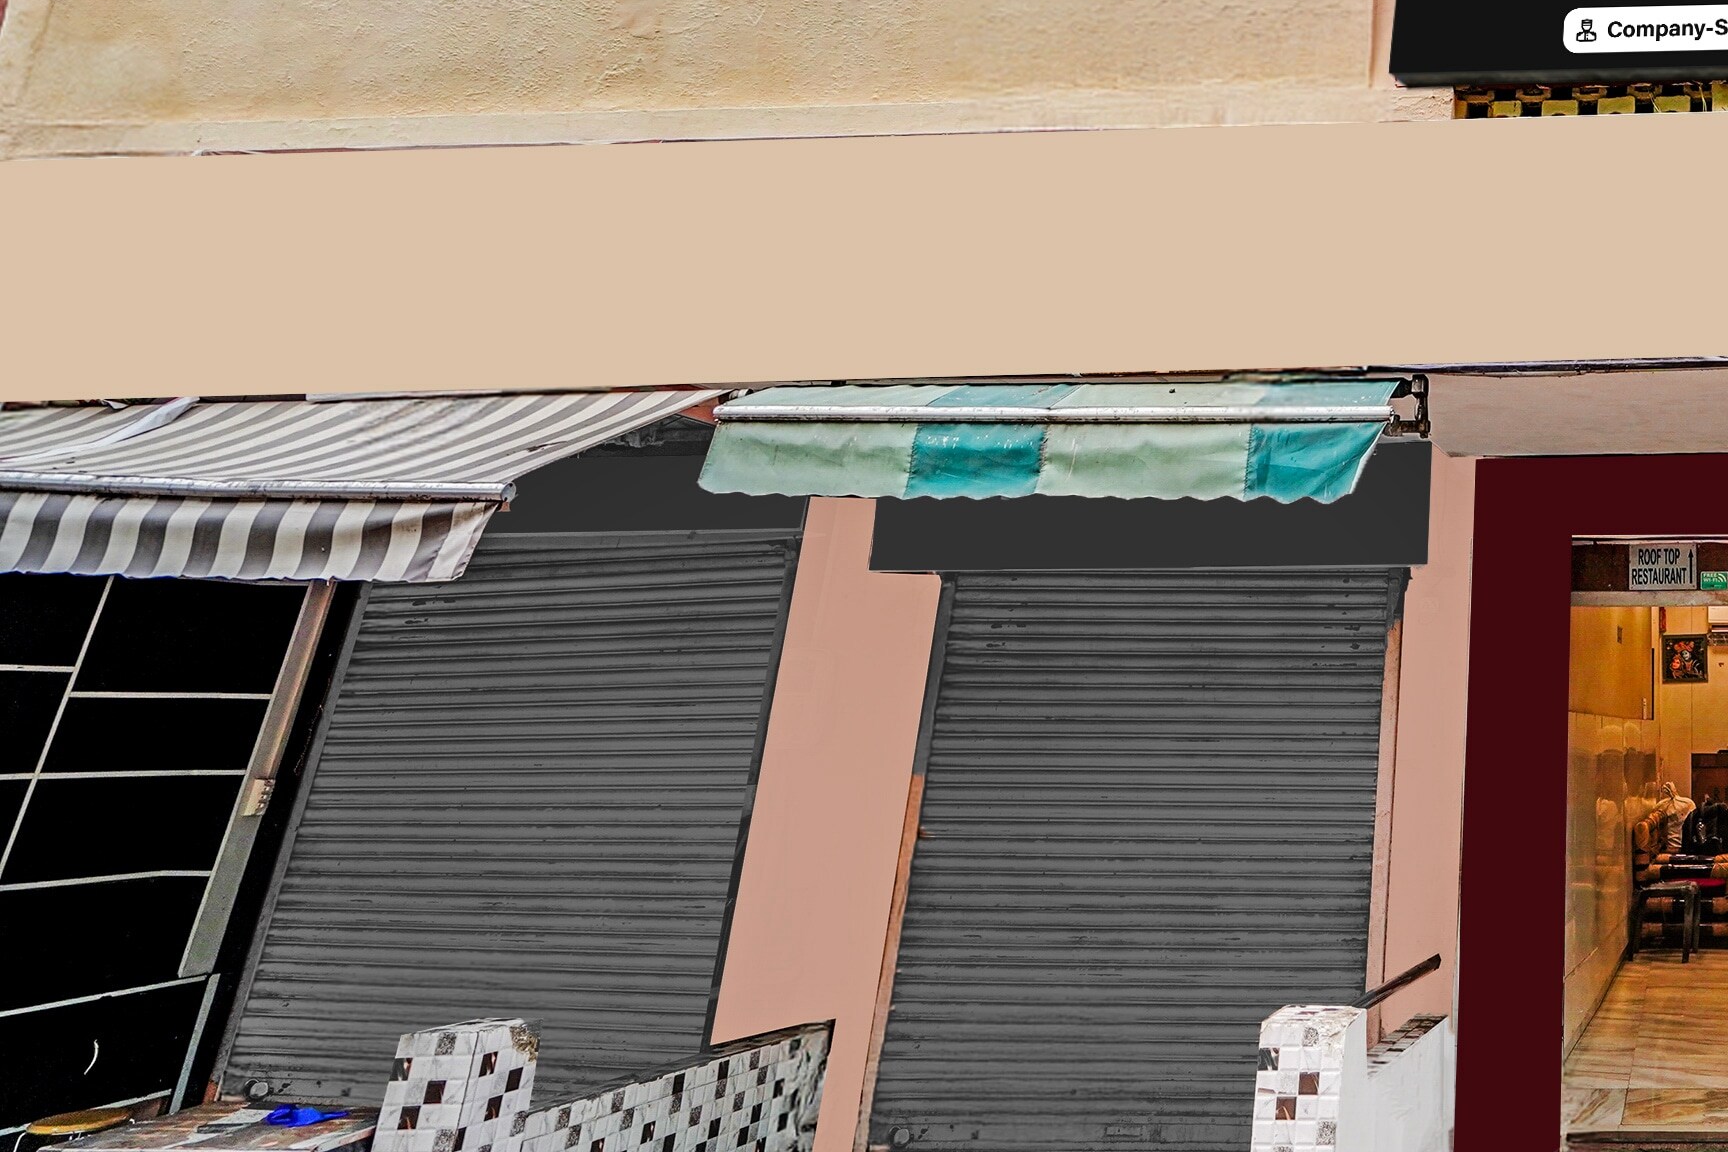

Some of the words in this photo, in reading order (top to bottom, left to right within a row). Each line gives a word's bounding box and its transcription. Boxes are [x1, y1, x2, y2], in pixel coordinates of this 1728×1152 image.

[1638, 548, 1661, 566] ROOF
[1664, 548, 1680, 565] TOP
[1632, 567, 1687, 585] RESTAURANT
